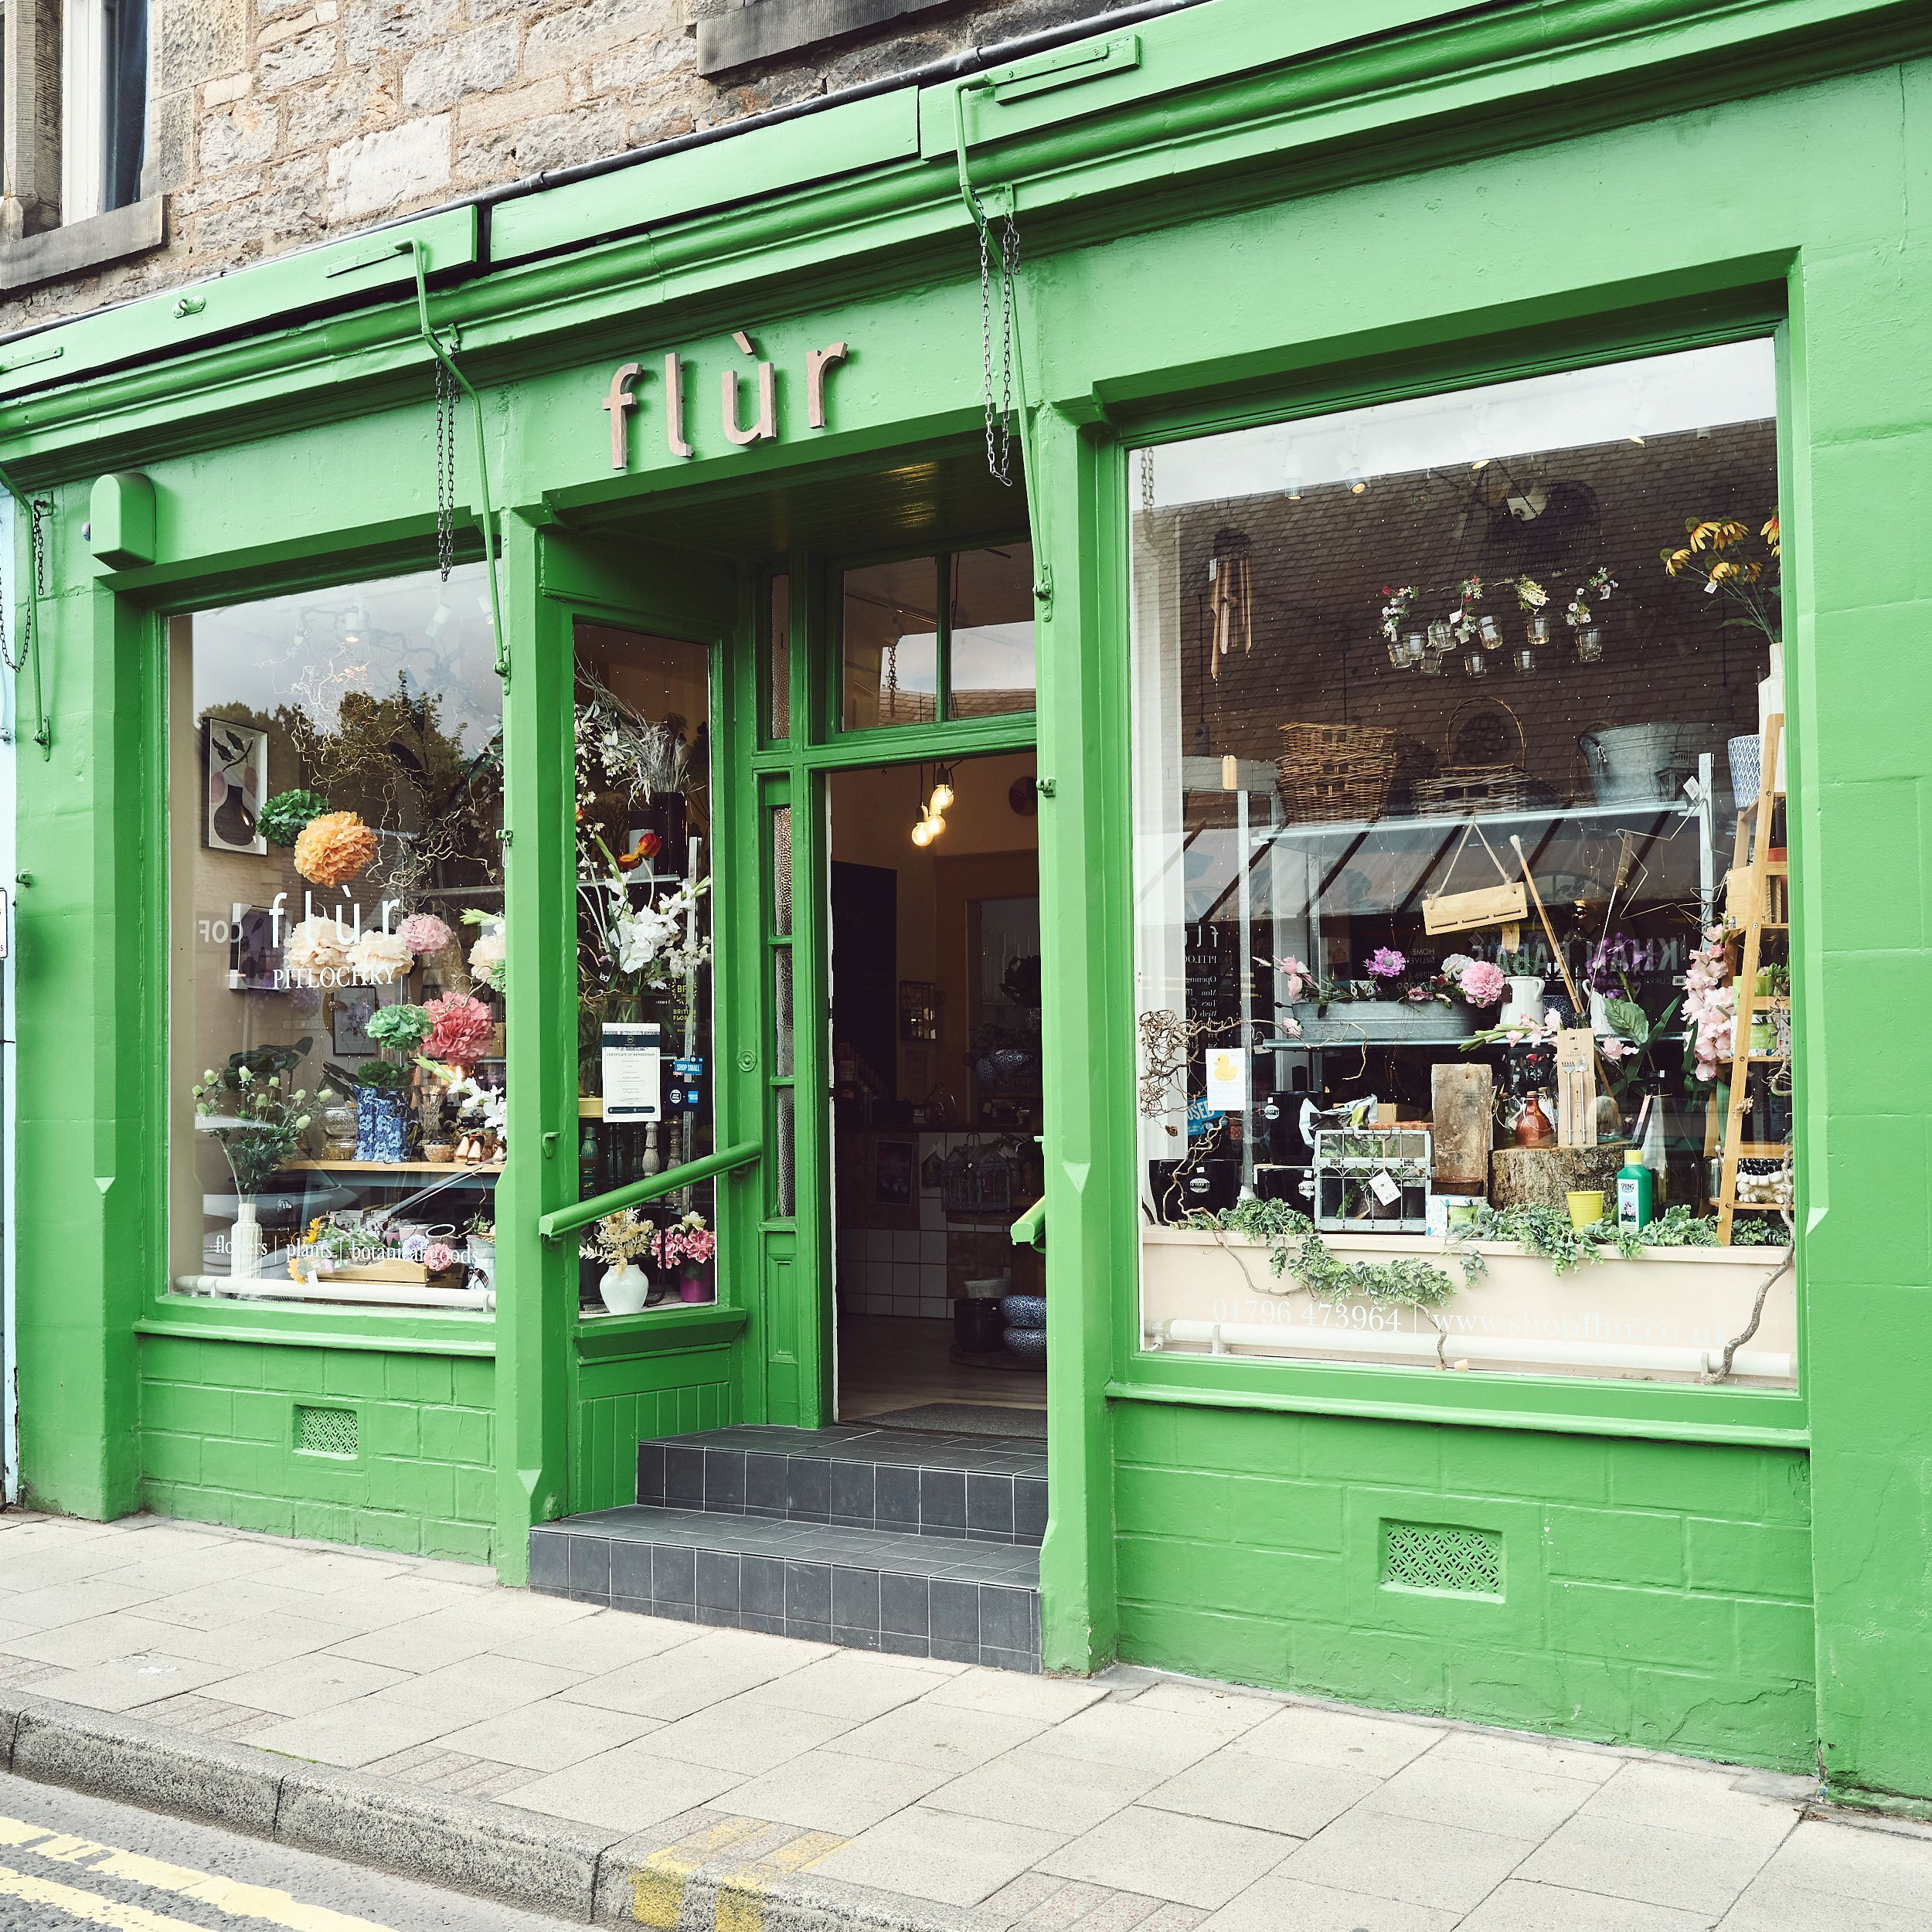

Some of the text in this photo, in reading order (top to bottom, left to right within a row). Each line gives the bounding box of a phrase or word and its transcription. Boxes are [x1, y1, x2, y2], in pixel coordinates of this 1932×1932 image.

[602, 331, 848, 470] flùr
[268, 884, 400, 948] flùr
[273, 964, 396, 990] PITLOCHRY
[215, 1235, 267, 1256] floers
[285, 1237, 332, 1261] plants
[1213, 1298, 1291, 1325] 01796
[1301, 1301, 1402, 1332] 473964
